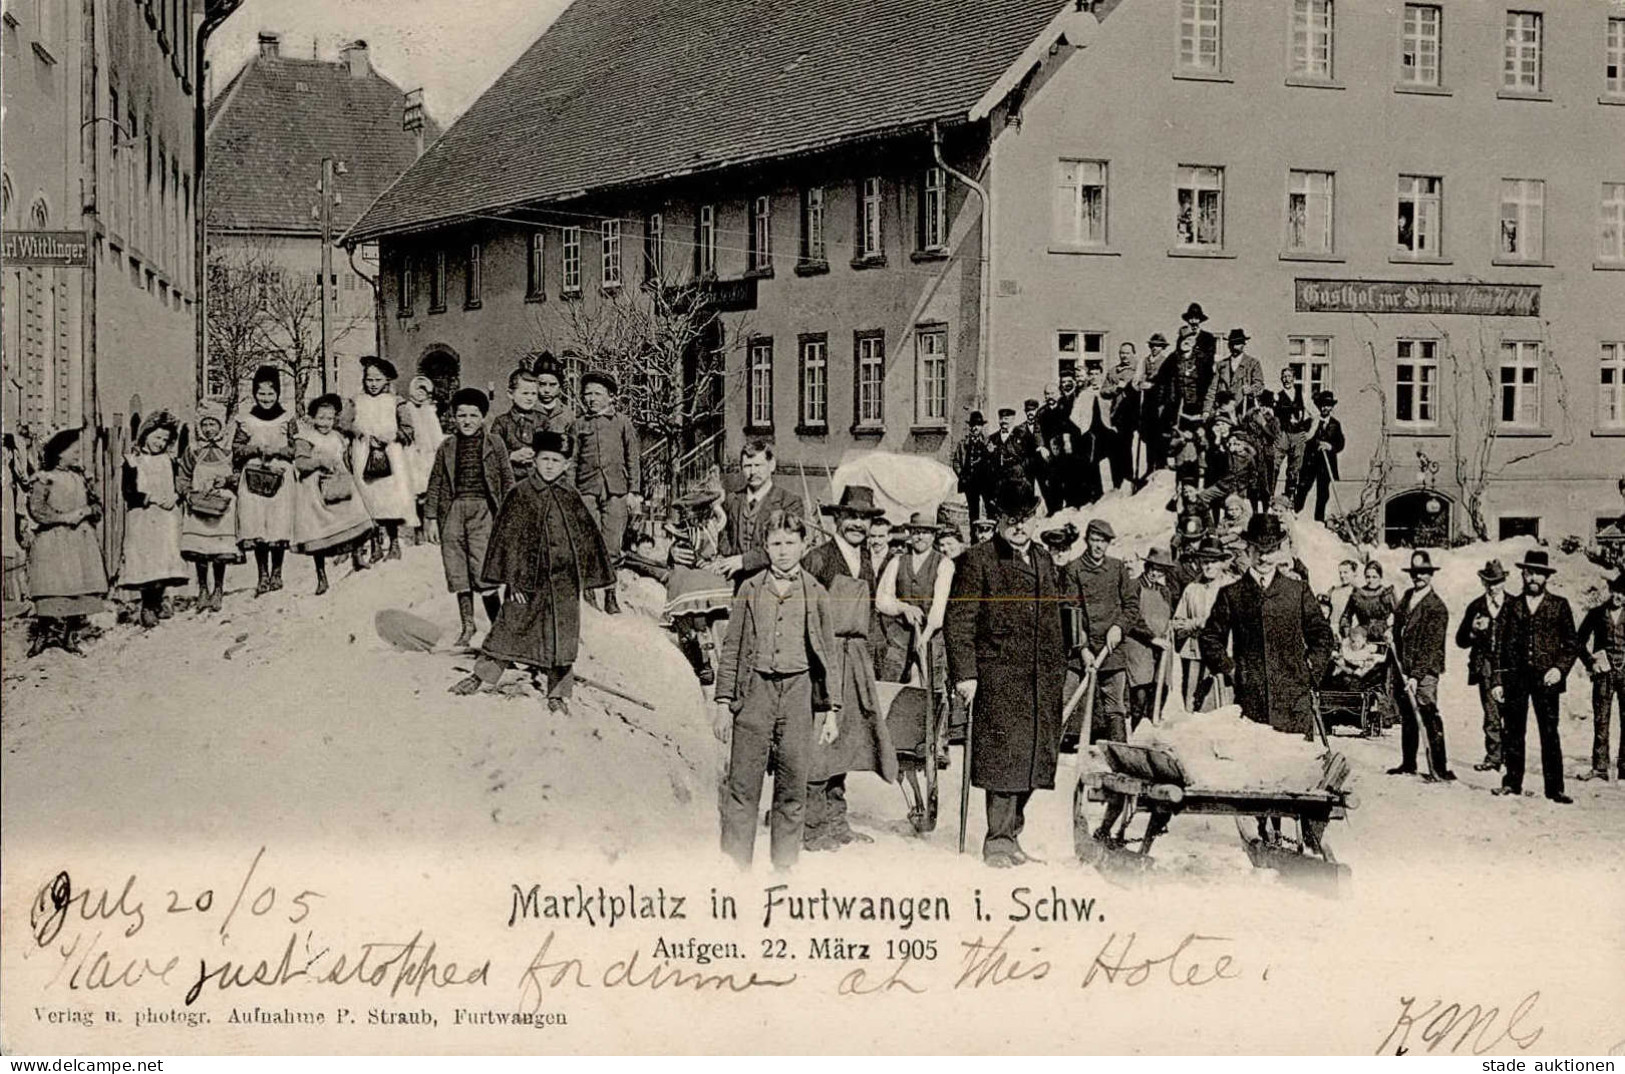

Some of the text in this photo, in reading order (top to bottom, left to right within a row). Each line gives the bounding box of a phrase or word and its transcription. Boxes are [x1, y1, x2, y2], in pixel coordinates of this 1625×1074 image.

[18, 235, 86, 264] Wittlinger
[1303, 283, 1377, 310] Gasthof
[1380, 292, 1401, 311] zur
[1403, 286, 1459, 309] Sonne
[30, 870, 145, 948] July
[318, 930, 491, 998] stopped
[518, 930, 592, 1014] for
[602, 950, 798, 992] dinner
